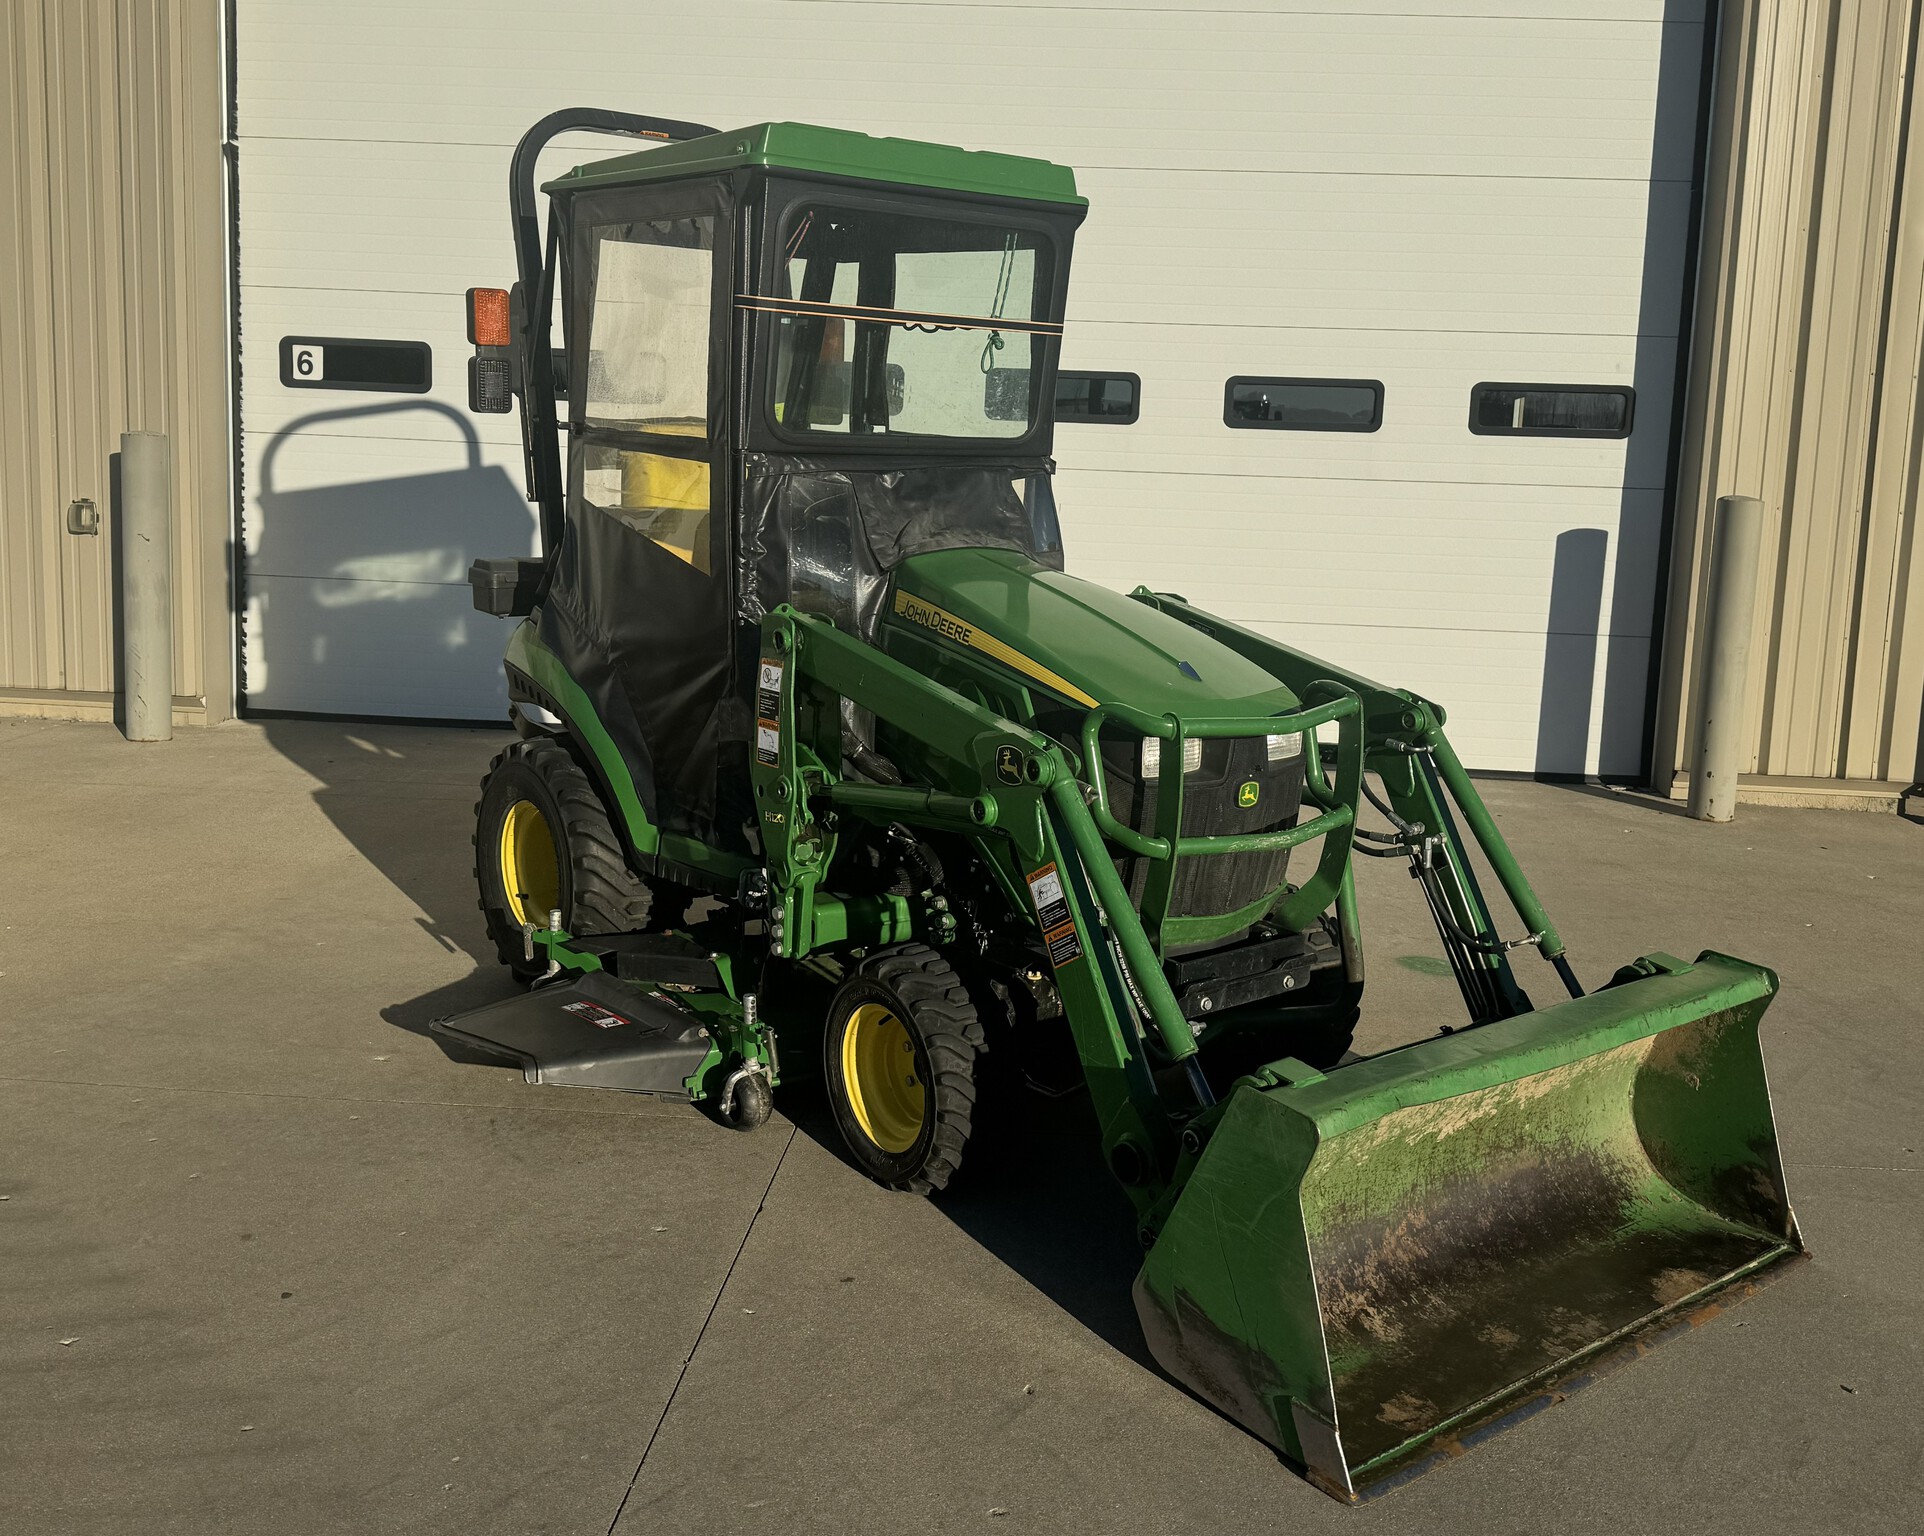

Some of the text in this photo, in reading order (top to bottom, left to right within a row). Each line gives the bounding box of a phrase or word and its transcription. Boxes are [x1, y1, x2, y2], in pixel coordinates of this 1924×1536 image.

[297, 350, 314, 376] 6
[900, 600, 973, 644] JOHN DEERE
[1053, 926, 1073, 939] WARNING
